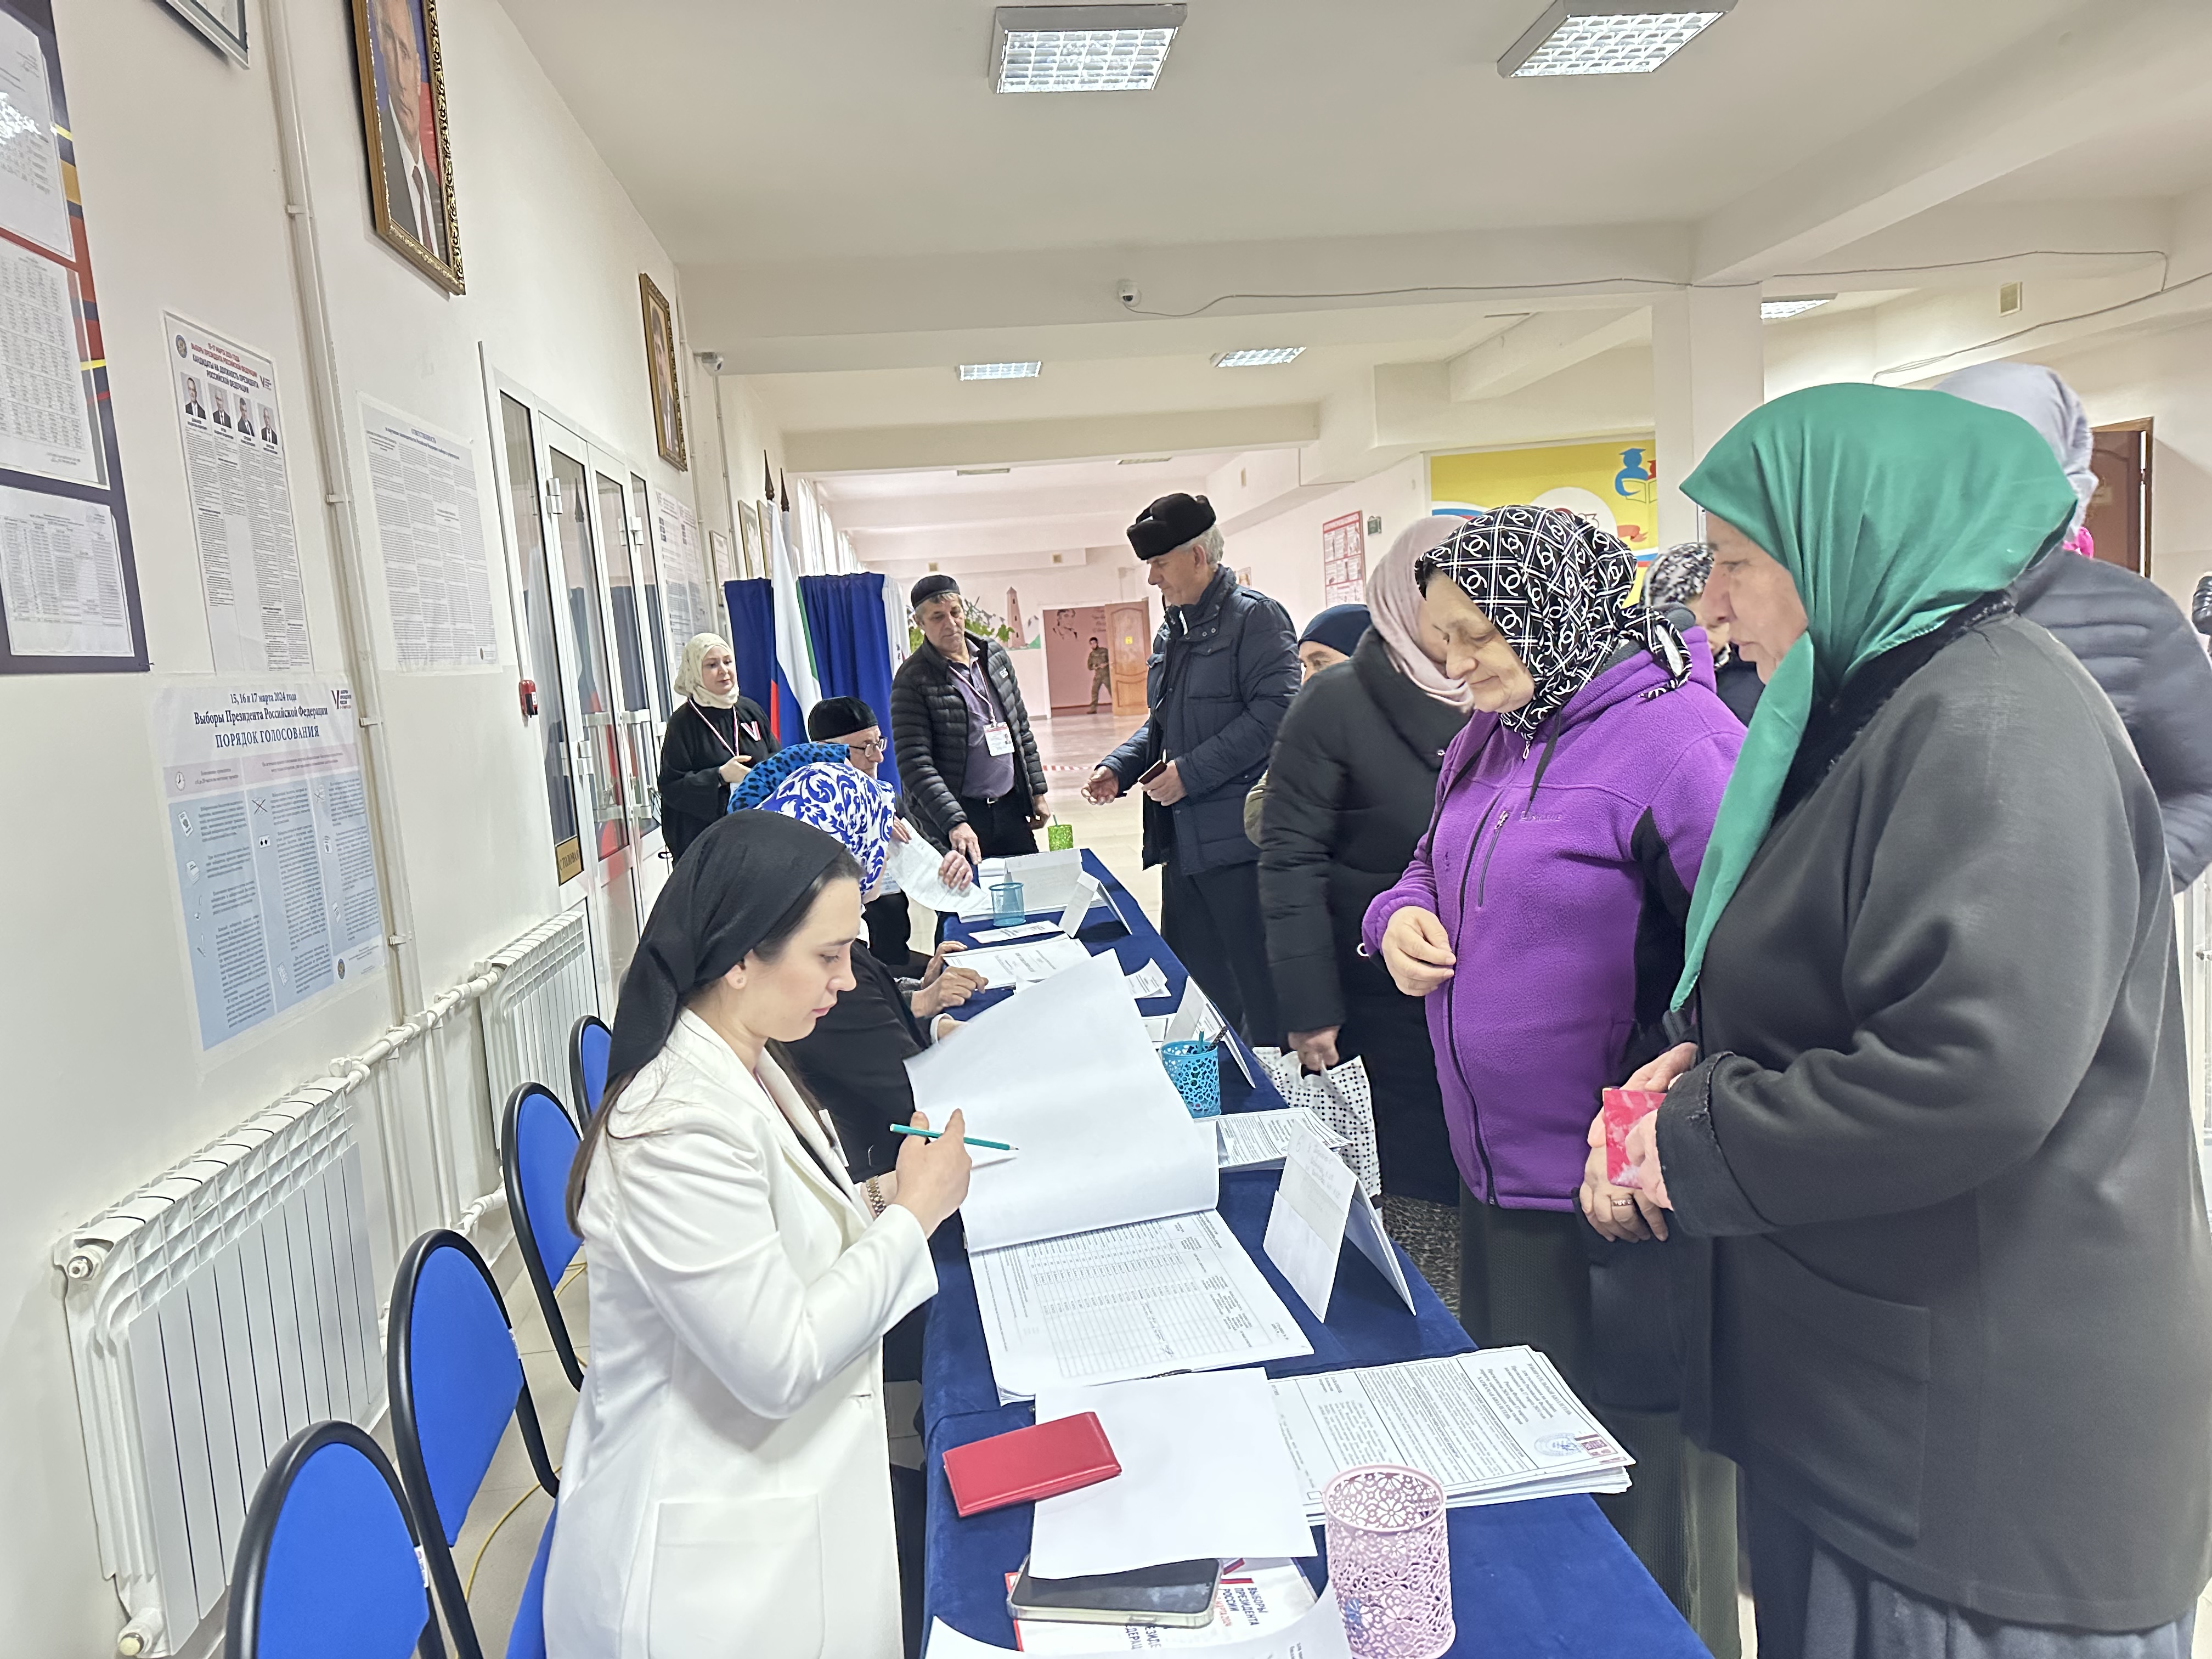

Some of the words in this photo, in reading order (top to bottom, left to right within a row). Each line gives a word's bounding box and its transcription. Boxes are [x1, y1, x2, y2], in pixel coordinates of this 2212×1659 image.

[230, 693, 239, 704] 15,
[240, 693, 246, 703] 16
[251, 693, 257, 703] 17
[258, 693, 274, 705] марта
[274, 692, 285, 702] 2024
[286, 693, 297, 701] года
[194, 712, 224, 727] Выборы
[225, 710, 263, 725] Президента
[264, 706, 298, 720] Российской
[298, 706, 328, 719] Федерации
[216, 731, 258, 748] ПОРЯДОК
[261, 726, 319, 743] ГОЛОСОВАНИЯ
[560, 850, 579, 871] СТОЛОВАЯ
[1527, 1363, 1555, 1395] ИЗБИРАТЕЛЬНЫЙ
[1551, 1395, 1572, 1415] БЮЛЛЕТЕНЬ
[1219, 1588, 1239, 1611] РОССИИ
[1234, 1588, 1260, 1626] ПРЕЗИДЕНТА
[1248, 1587, 1268, 1613] ВЫБОРЫ
